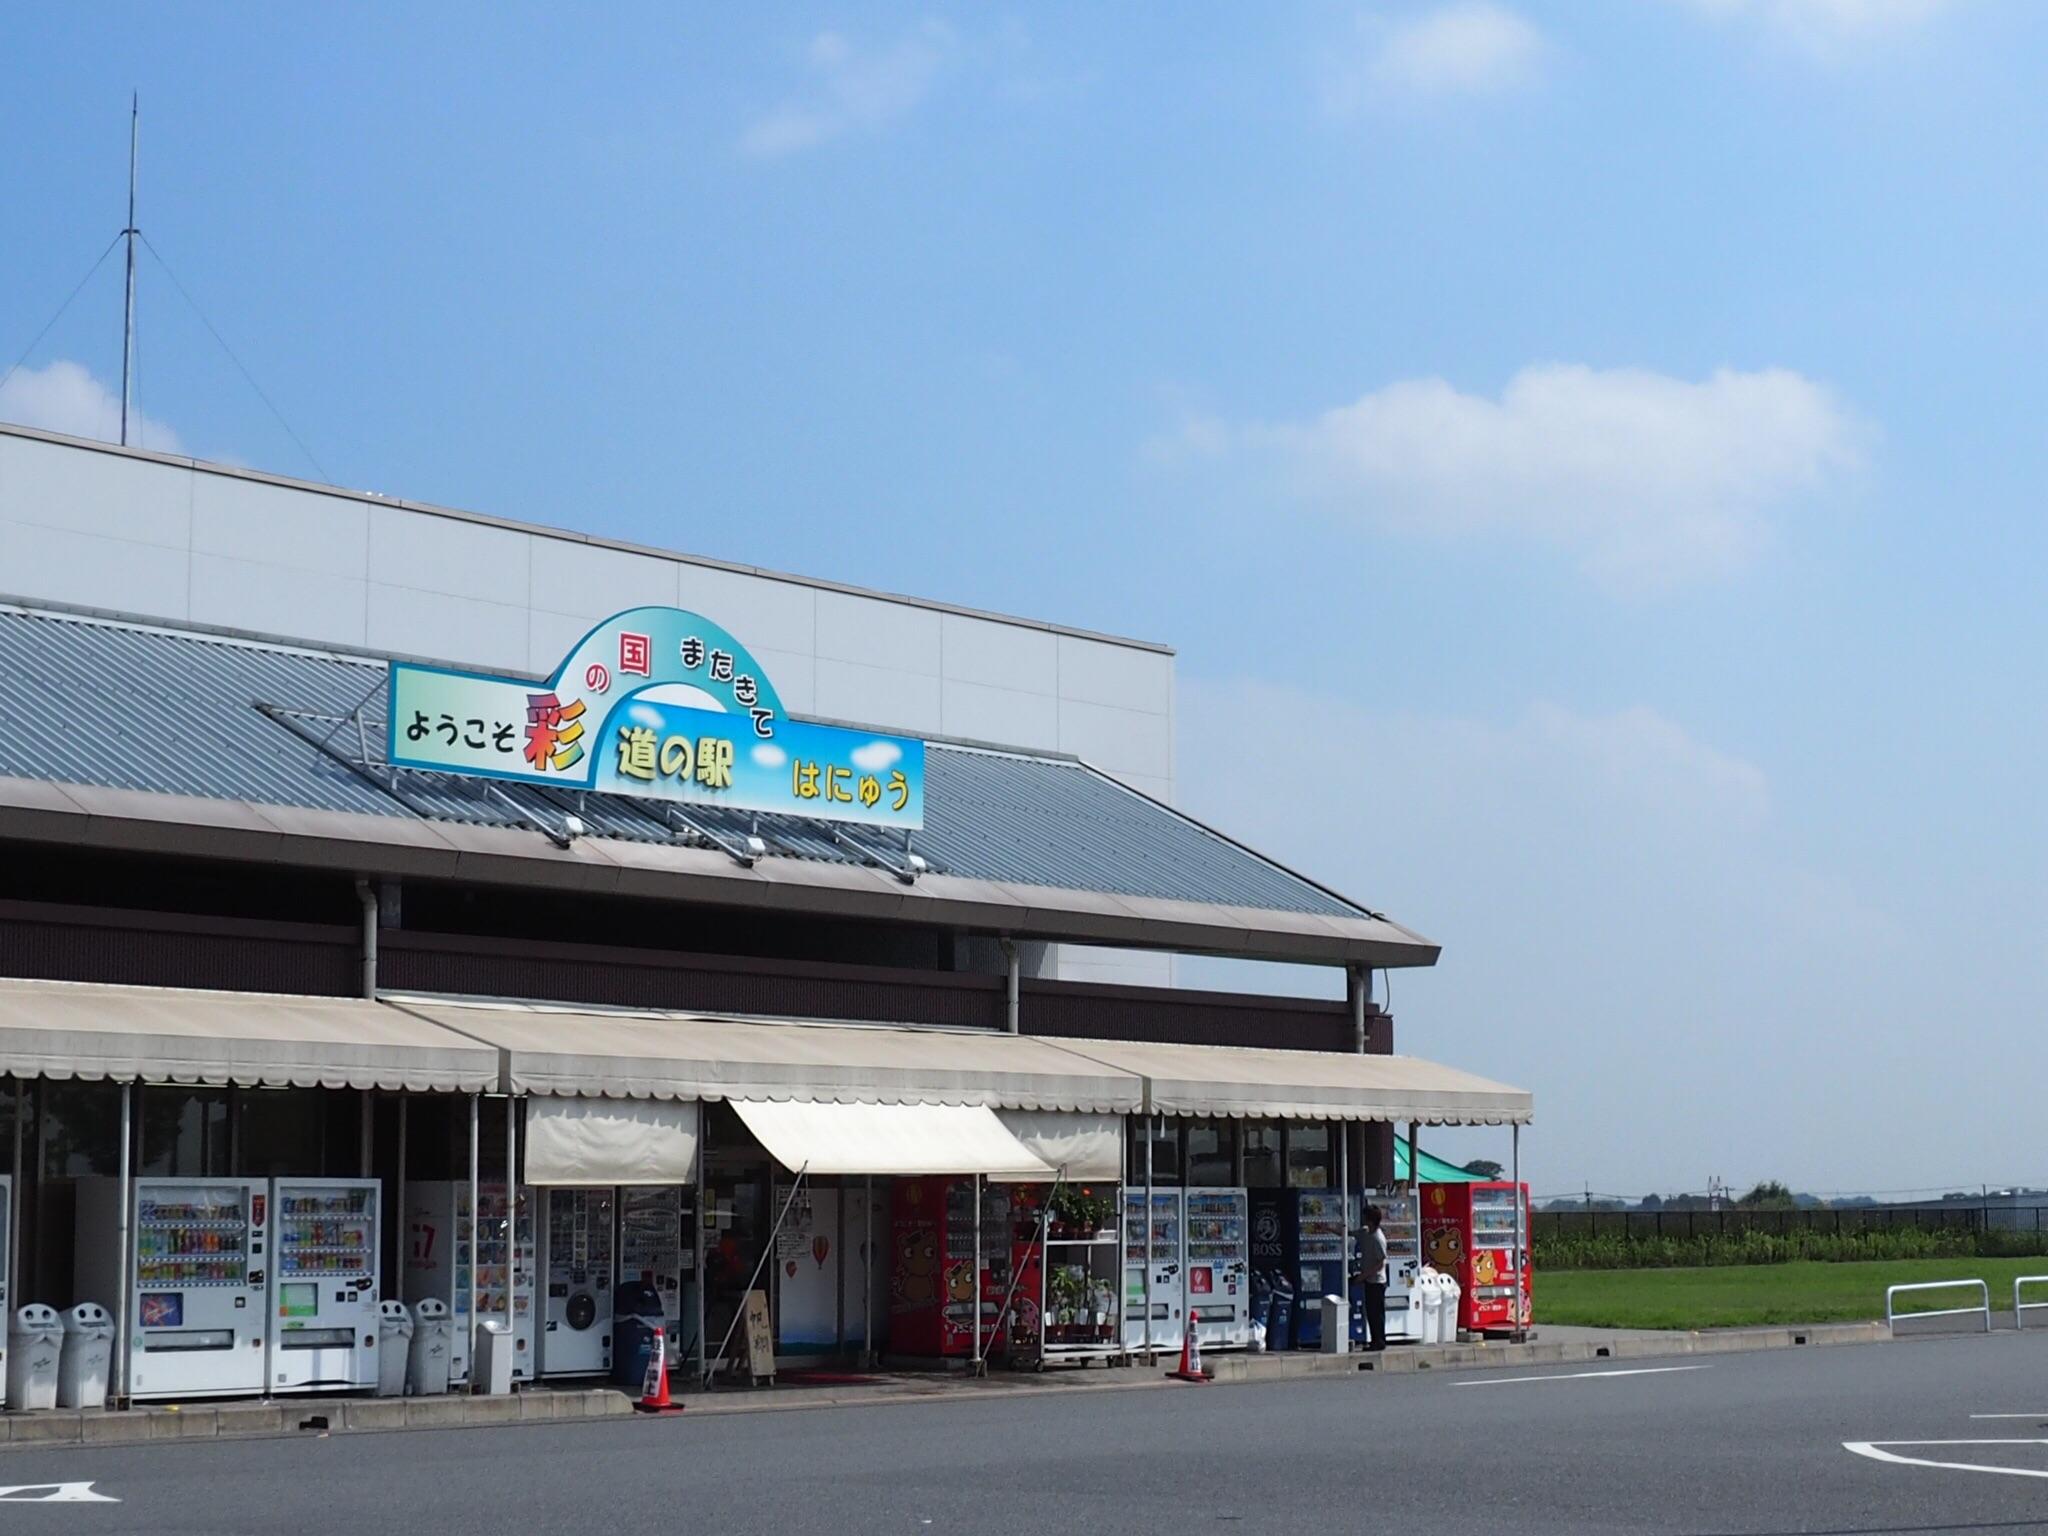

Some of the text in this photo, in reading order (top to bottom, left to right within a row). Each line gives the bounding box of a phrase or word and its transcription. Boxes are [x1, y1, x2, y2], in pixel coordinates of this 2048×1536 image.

[407, 632, 651, 771] ようこそ 彩の国
[681, 638, 775, 739] またきて
[618, 726, 909, 811] 道の駅 はにゅう
[1254, 1243, 1282, 1257] BOSS
